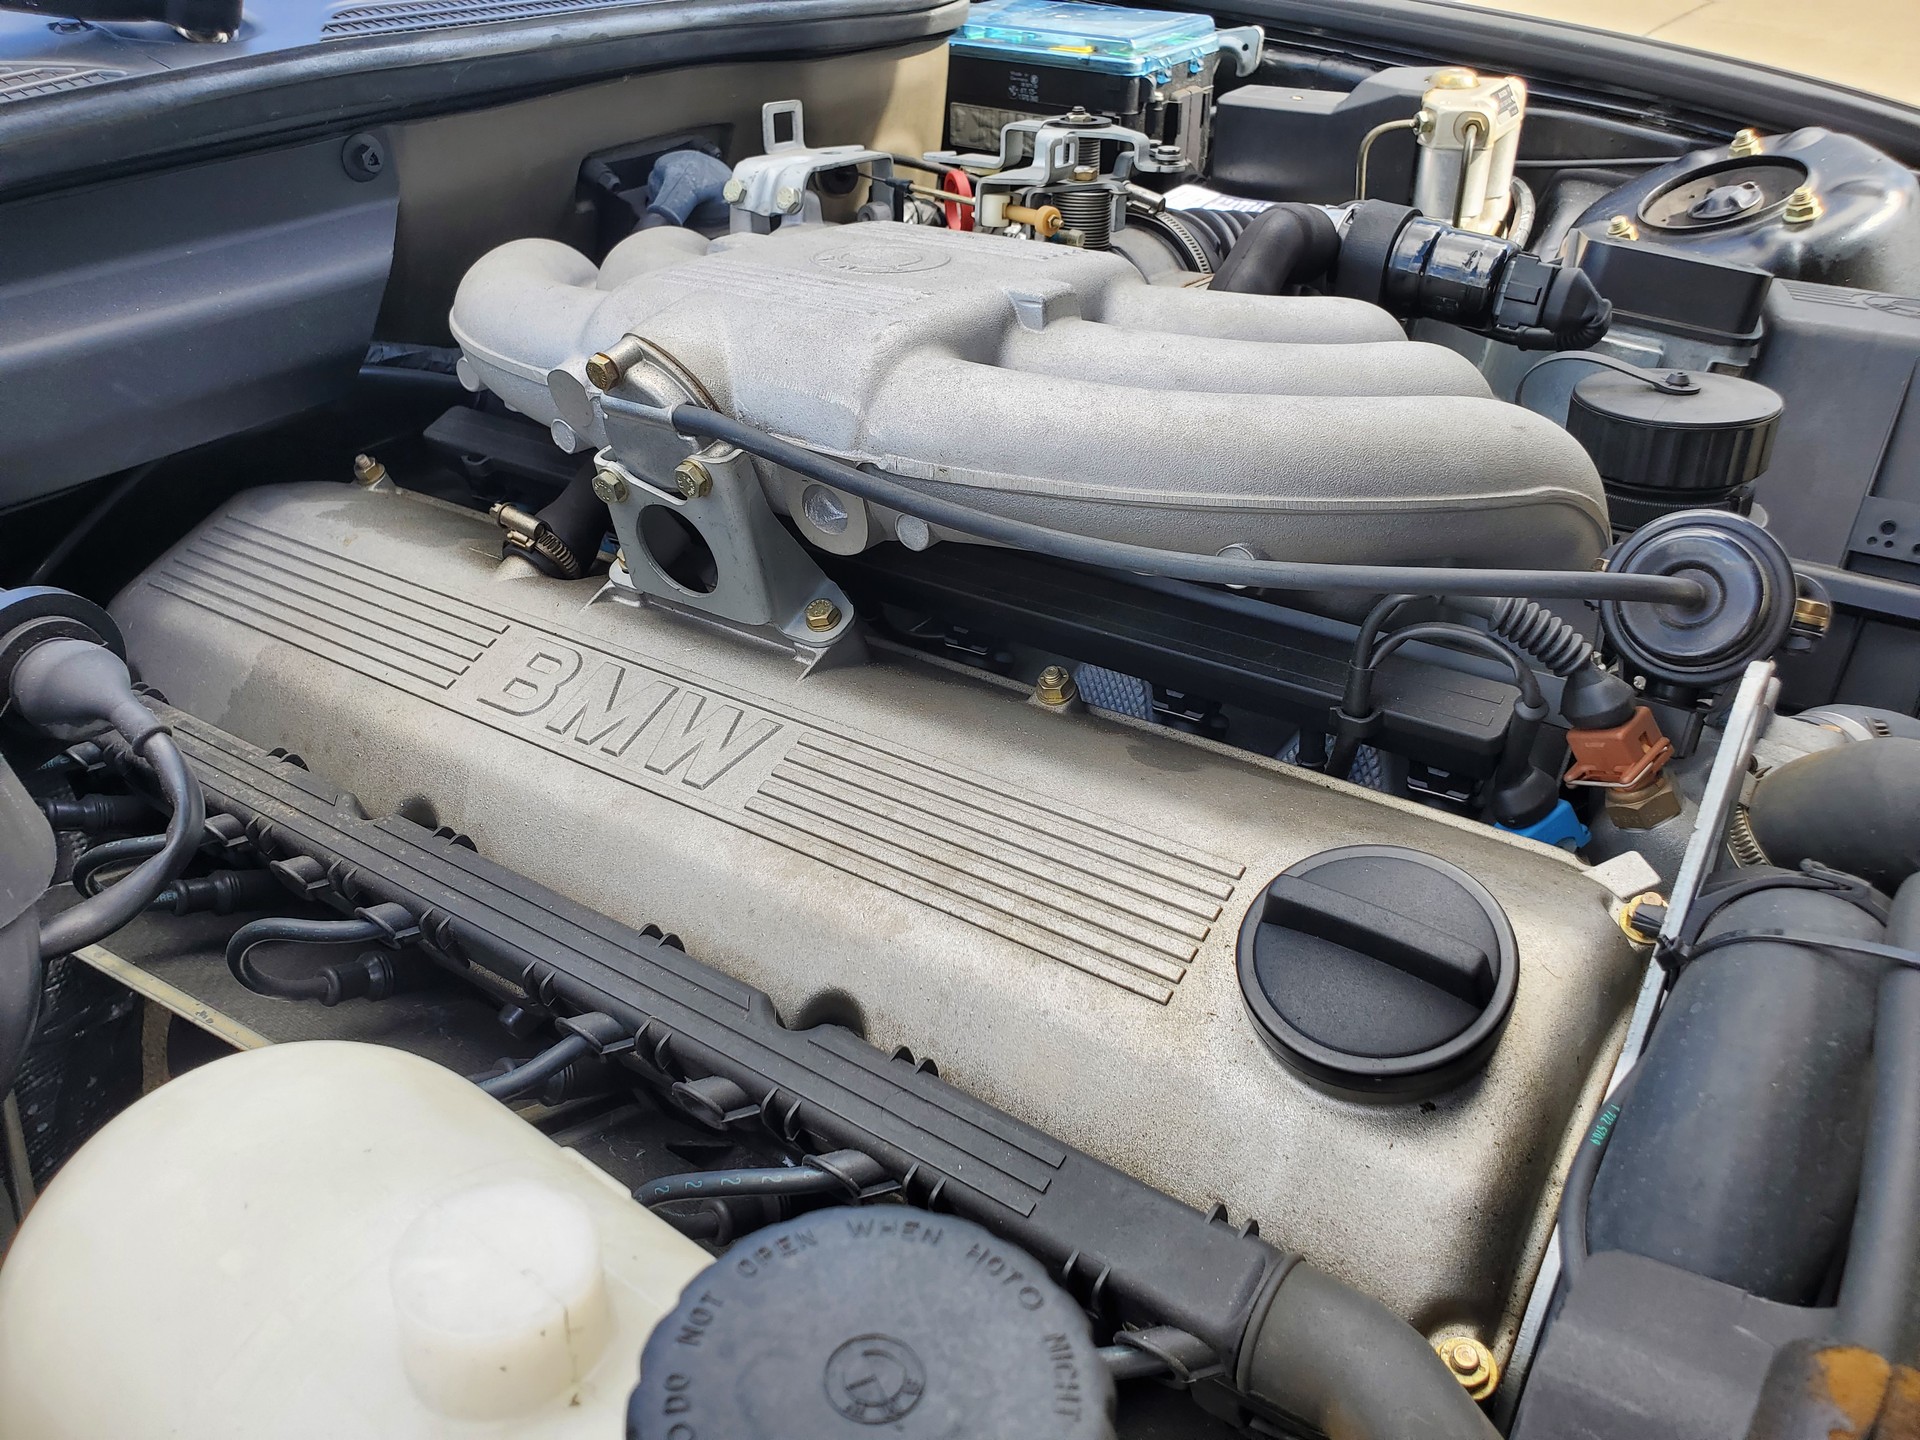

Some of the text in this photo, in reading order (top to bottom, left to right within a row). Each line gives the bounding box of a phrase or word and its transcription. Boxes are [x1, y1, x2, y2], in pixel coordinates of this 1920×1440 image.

[476, 637, 784, 791] BMW
[676, 1289, 726, 1348] NOT
[736, 1227, 819, 1279] OPEN
[845, 1217, 946, 1247] WHEN
[1043, 1331, 1083, 1424] NICHT
